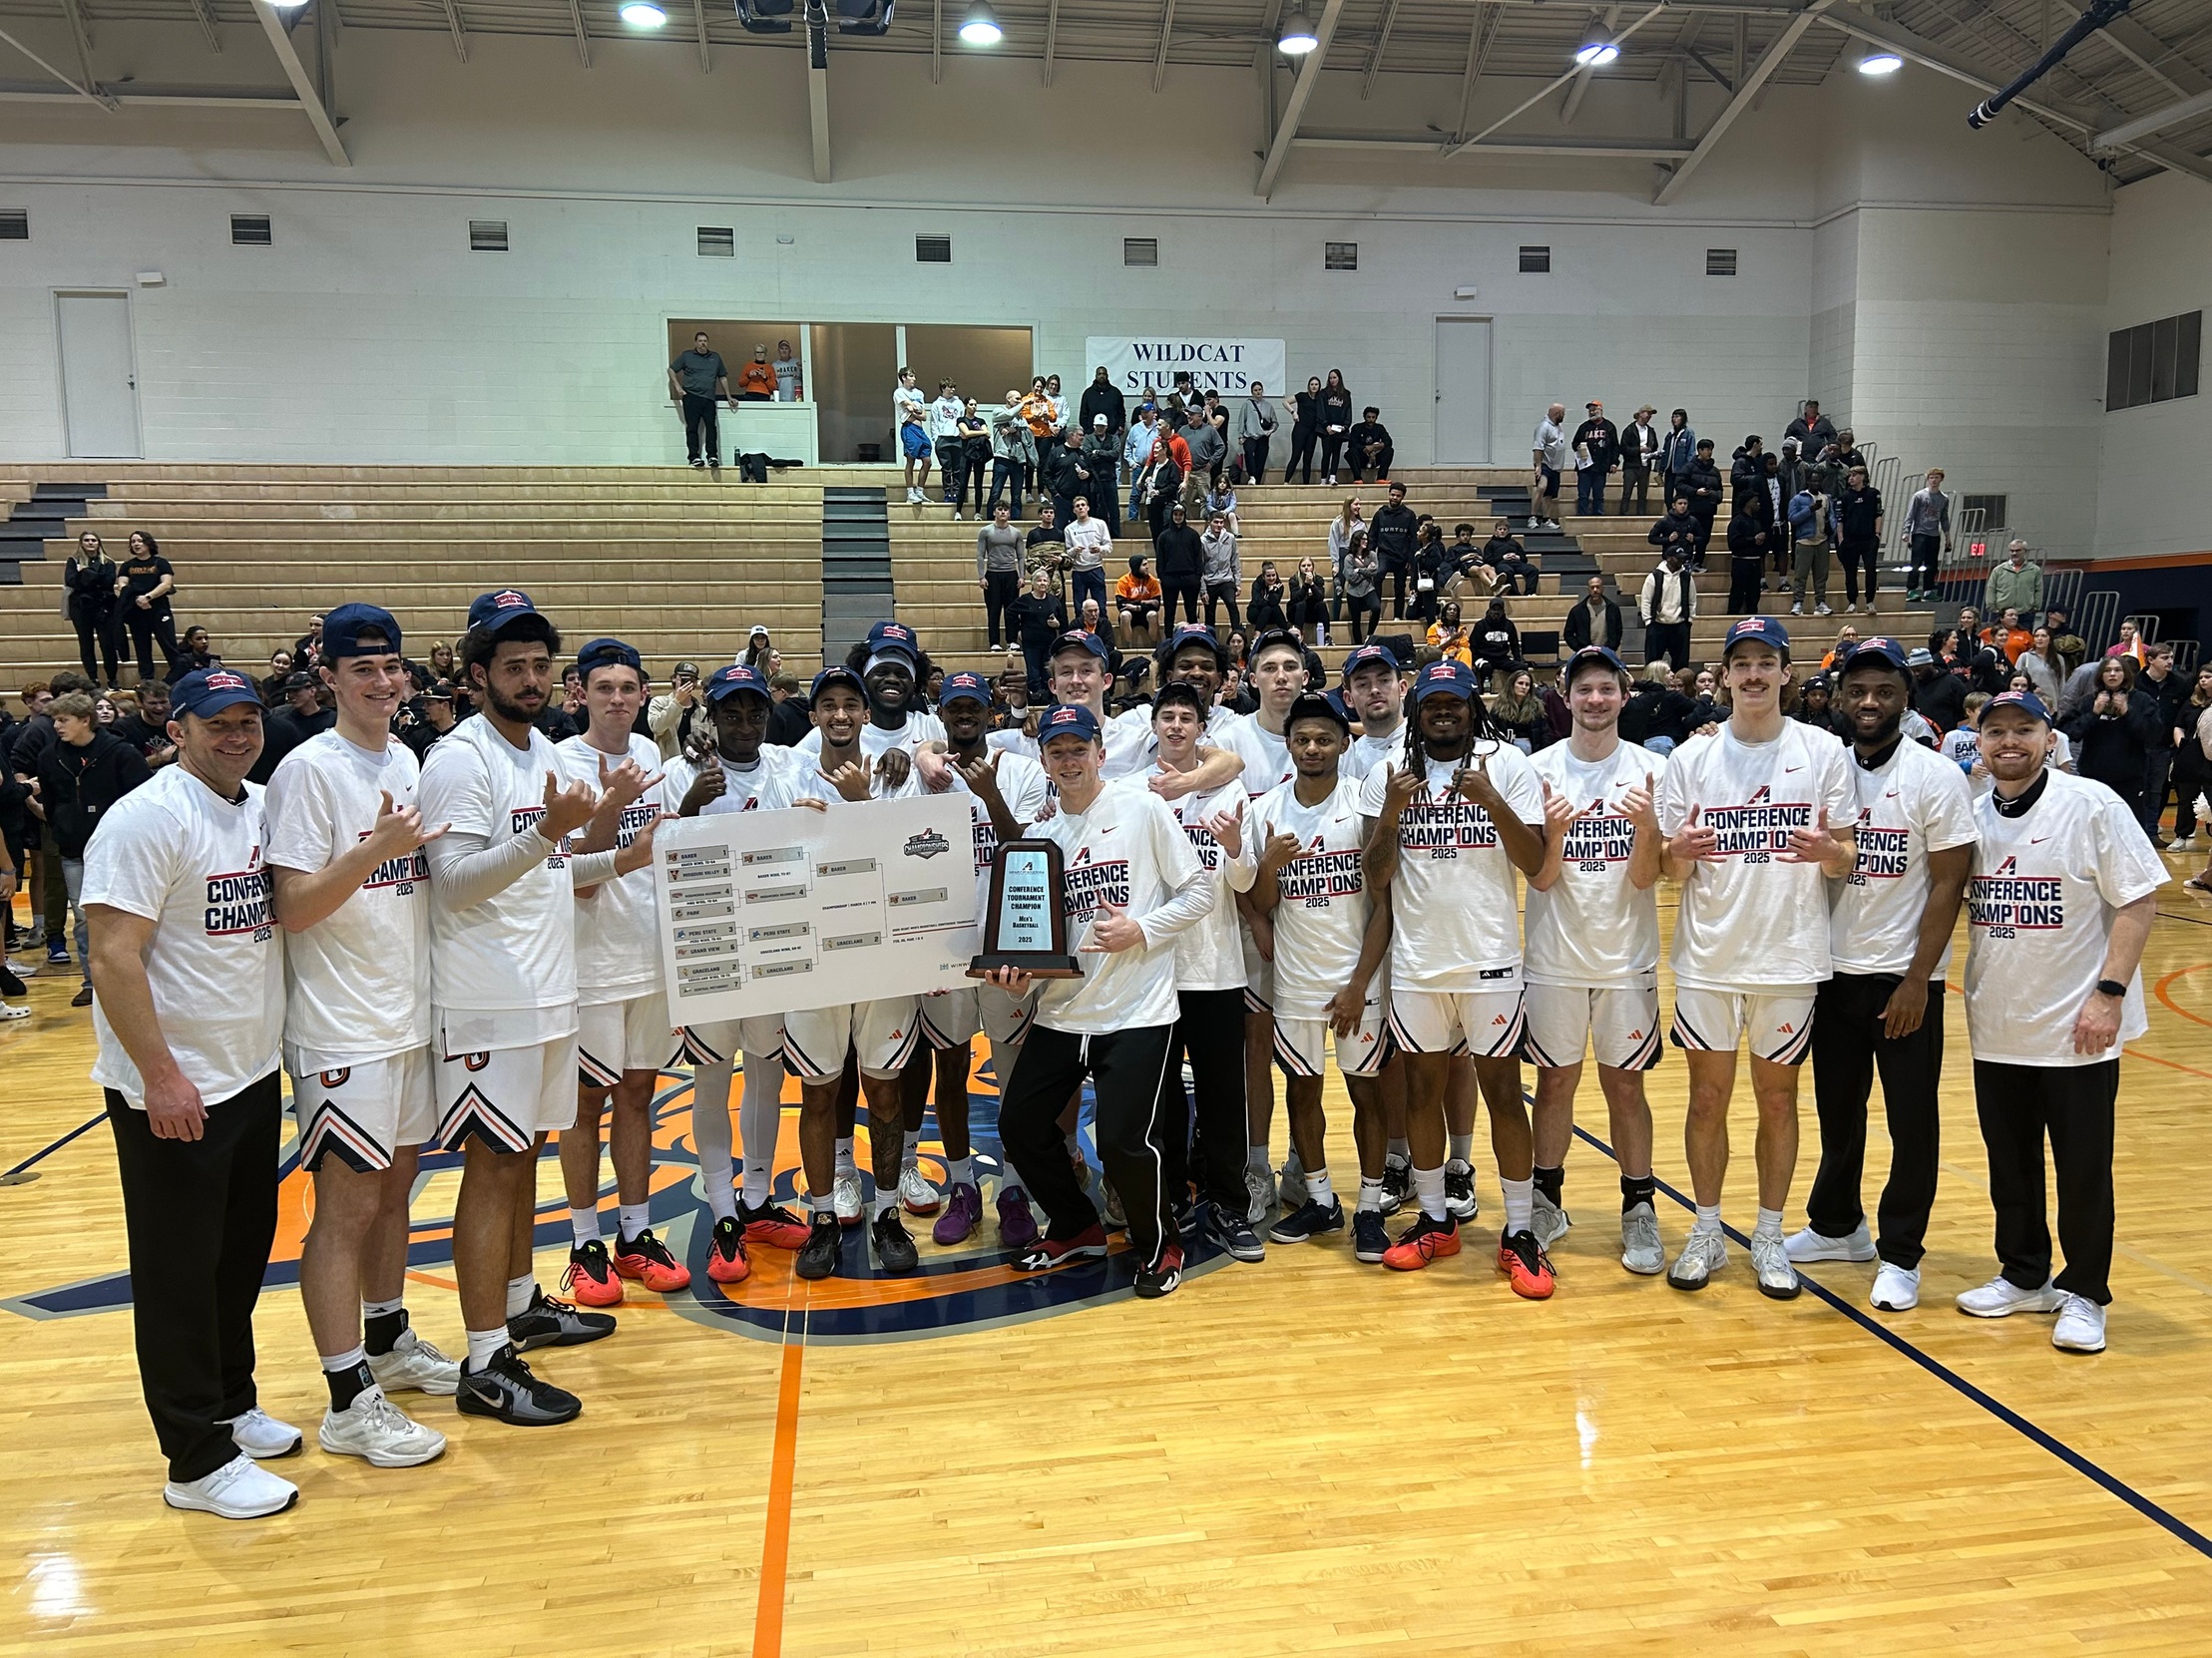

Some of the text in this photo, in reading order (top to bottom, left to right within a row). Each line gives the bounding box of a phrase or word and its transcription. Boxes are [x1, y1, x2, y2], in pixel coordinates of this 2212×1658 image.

[1132, 344, 1245, 363] WILDCAT
[1955, 743, 1978, 753] BAK
[1704, 808, 1811, 829] CONFERENCE
[1855, 831, 1908, 852] ERENCE
[1431, 848, 1457, 859] 2025
[1744, 852, 1770, 863] 2025
[548, 857, 565, 869] 2025
[1277, 853, 1361, 877] ONFERENCE
[1580, 861, 1605, 871] 2025
[1848, 874, 1866, 886] 025
[396, 881, 414, 896] 2025
[1971, 881, 2062, 901] ONFERENCE
[1306, 897, 1329, 908] 2025
[1078, 911, 1094, 923] 202
[254, 925, 271, 943] 2025
[1990, 927, 2015, 939] 2025
